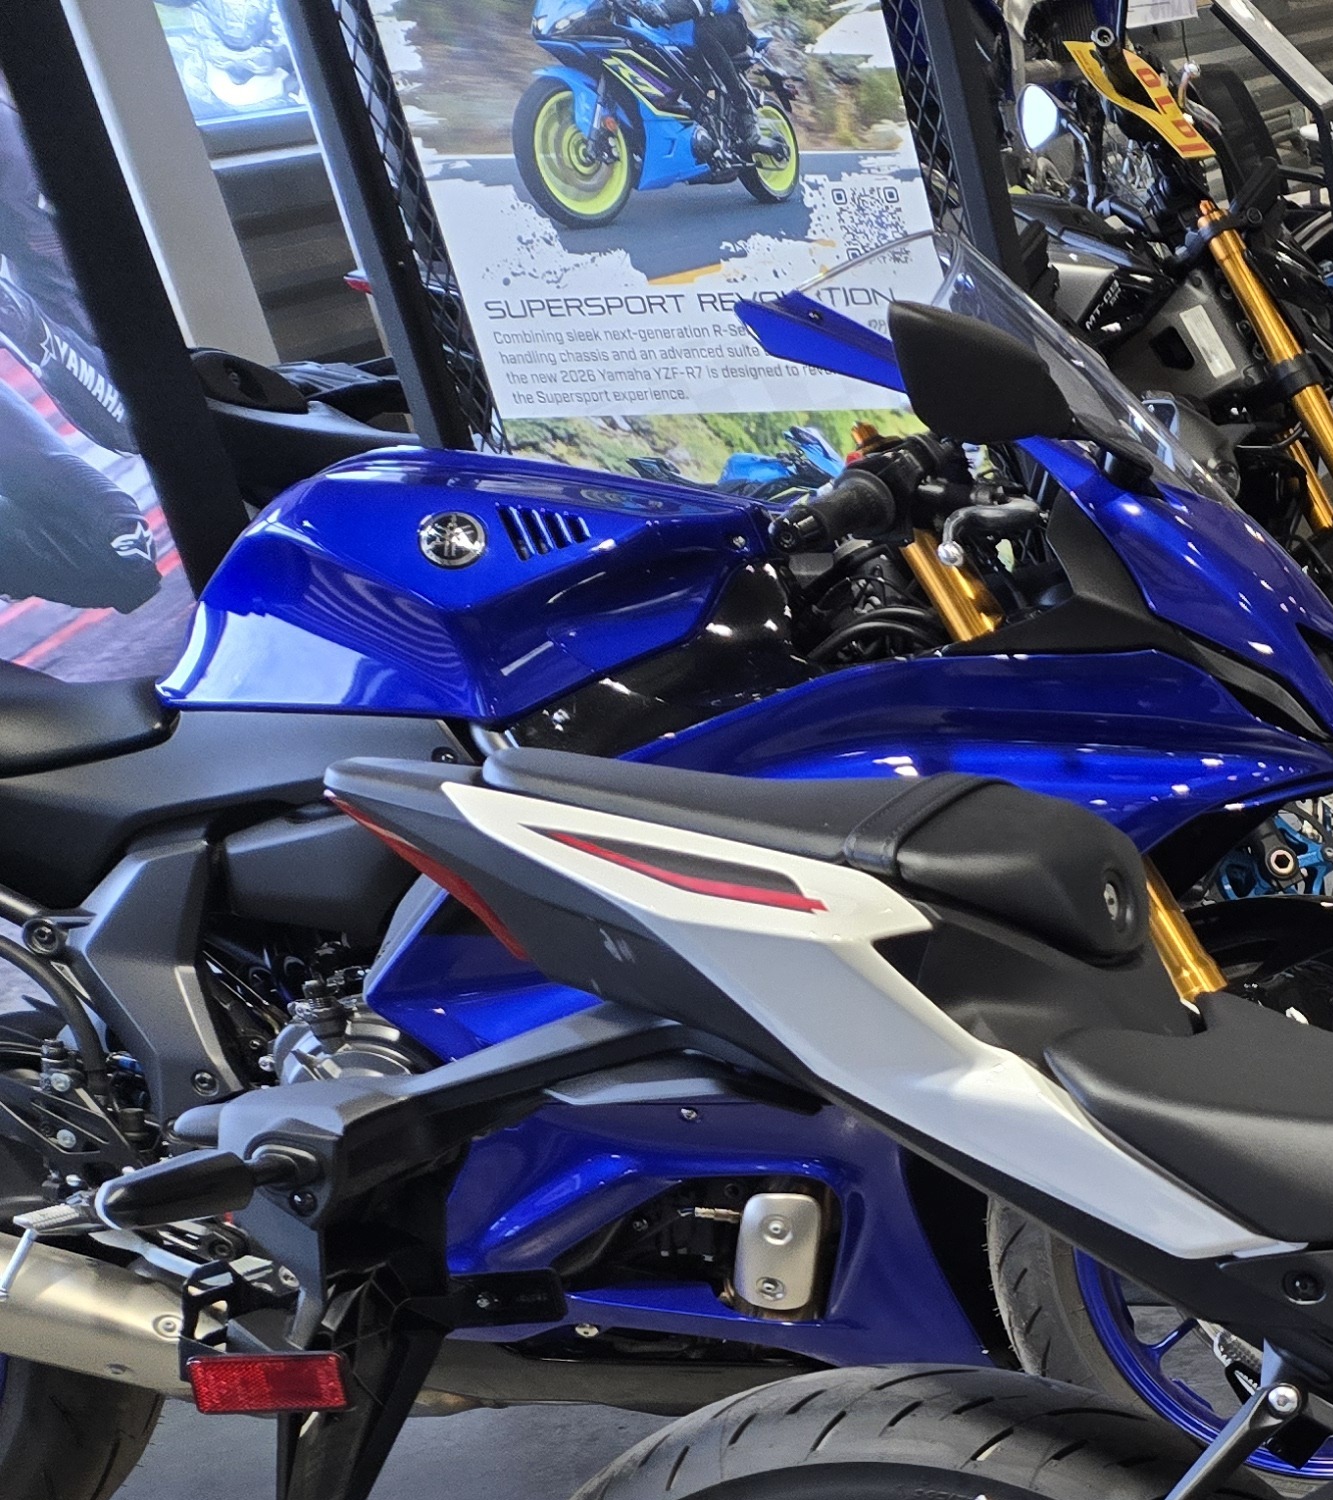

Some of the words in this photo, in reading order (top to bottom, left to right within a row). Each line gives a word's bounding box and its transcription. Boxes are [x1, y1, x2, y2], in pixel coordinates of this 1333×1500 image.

[484, 293, 686, 320] SUPERSPORT
[697, 285, 897, 312] REVOTION
[493, 326, 565, 347] Combining
[567, 327, 602, 343] sleek
[604, 323, 711, 343] next-generation
[499, 348, 557, 367] handling
[560, 348, 610, 364] chassis
[613, 347, 637, 362] and
[640, 349, 657, 362] an
[660, 344, 725, 361] advanced
[728, 343, 760, 359] suite
[53, 334, 125, 423] YAMAHA
[506, 371, 529, 386] the
[531, 373, 558, 385] new
[561, 368, 596, 384] 2026
[597, 366, 652, 383] Yamaha
[654, 365, 703, 382] YZF-R7
[707, 364, 719, 379] is
[722, 363, 783, 382] designed
[785, 363, 800, 378] to
[512, 390, 534, 406] the
[536, 387, 610, 406] Supersport
[613, 386, 690, 403] experience.
